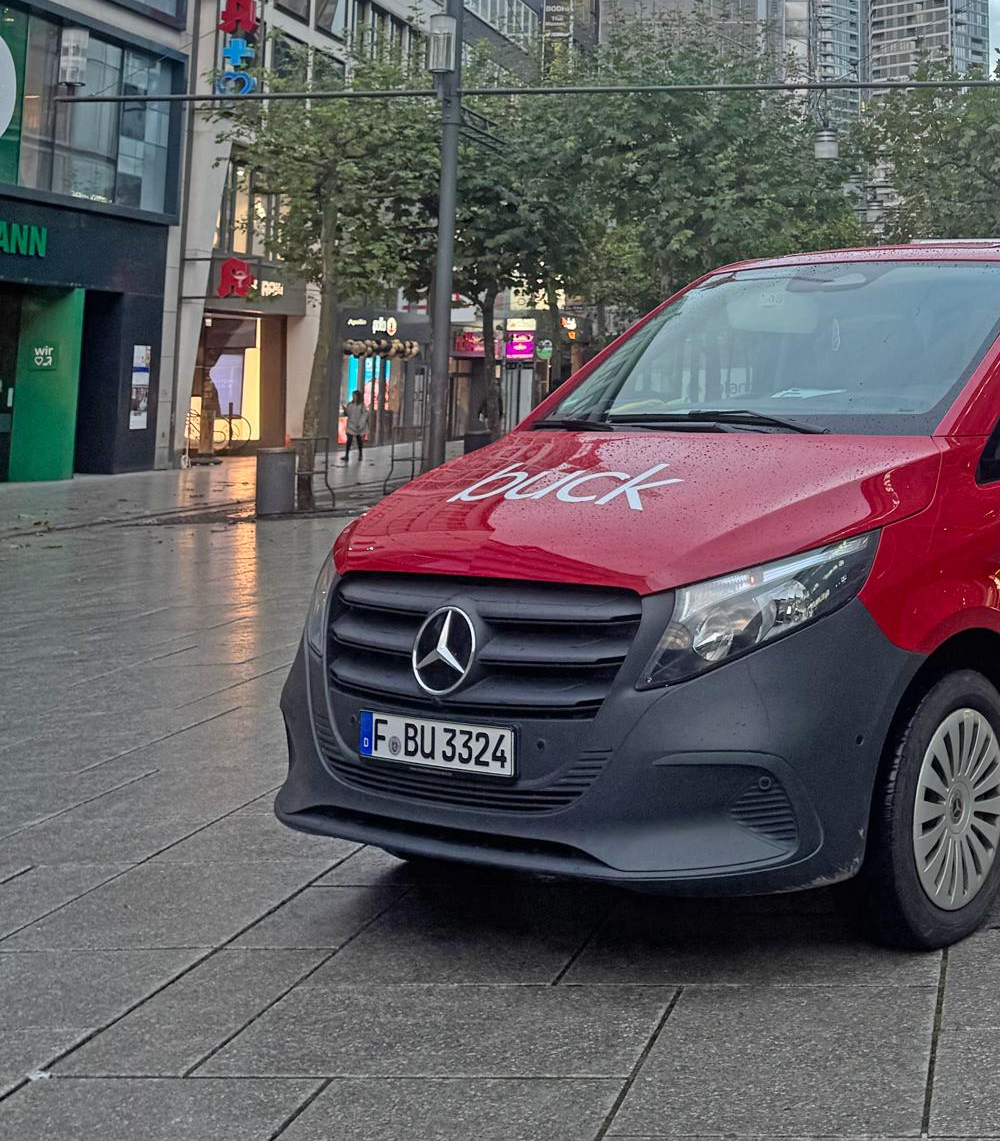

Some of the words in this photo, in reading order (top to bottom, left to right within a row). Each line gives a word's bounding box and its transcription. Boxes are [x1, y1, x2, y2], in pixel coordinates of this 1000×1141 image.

[34, 345, 54, 356] wir
[446, 462, 685, 511] buck
[374, 718, 388, 751] F
[404, 722, 436, 760] BU
[442, 727, 507, 769] 3324
